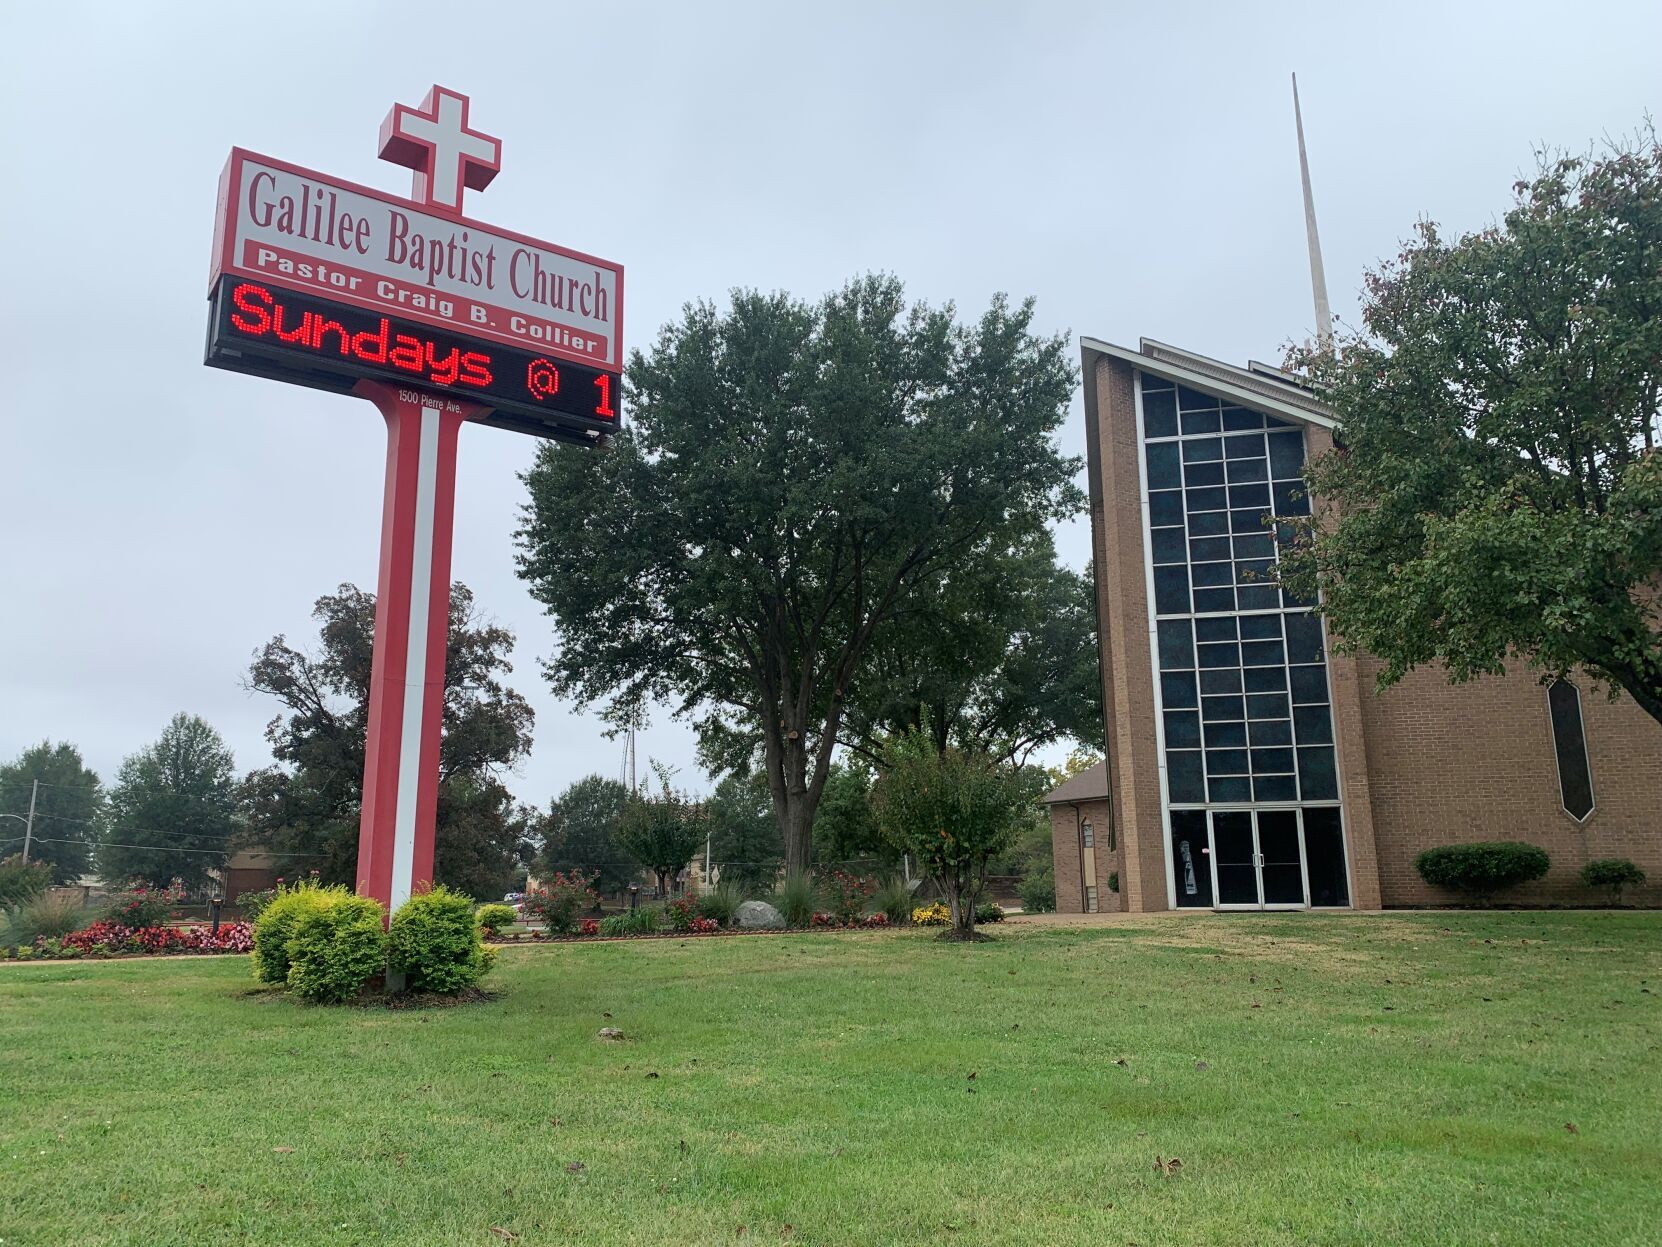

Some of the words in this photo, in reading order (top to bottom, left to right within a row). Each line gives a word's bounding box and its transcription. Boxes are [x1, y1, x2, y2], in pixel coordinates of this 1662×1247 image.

[248, 171, 371, 255] Galilee
[385, 209, 496, 291] Baptist
[509, 247, 609, 323] Church
[257, 248, 362, 291] Pastor
[376, 280, 454, 318] Craig
[469, 304, 497, 327] B.
[510, 316, 599, 354] Collier
[232, 283, 493, 387] Sundays
[526, 358, 559, 400] @
[593, 373, 615, 418] 1
[398, 389, 419, 404] 1500
[421, 394, 444, 409] Pierre
[447, 400, 462, 414] Ave.
